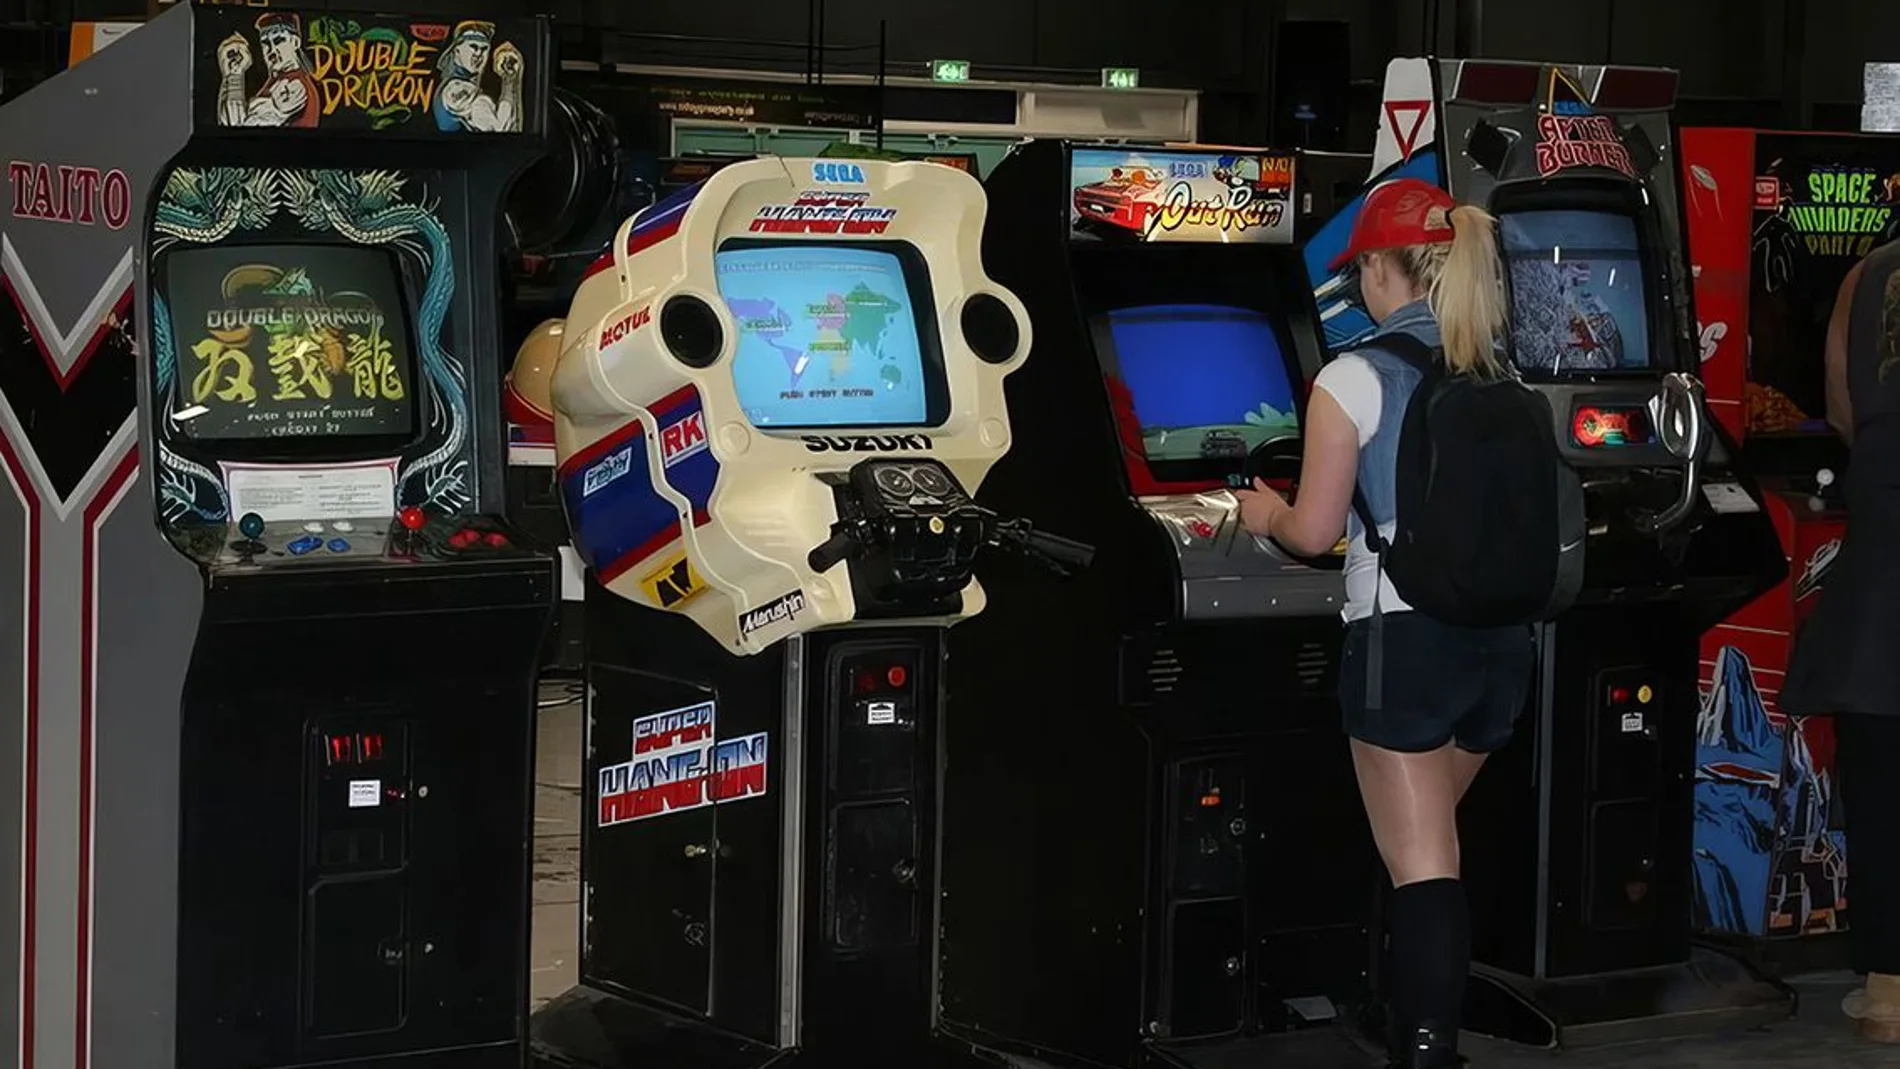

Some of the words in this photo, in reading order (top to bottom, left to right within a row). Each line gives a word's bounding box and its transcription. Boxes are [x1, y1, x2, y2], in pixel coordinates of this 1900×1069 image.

[309, 40, 438, 82] DOUBLE
[322, 70, 435, 115] DRAGON
[812, 162, 866, 184] SEGA
[1535, 140, 1636, 178] BURNER
[8, 160, 131, 230] TAITO
[1808, 172, 1877, 204] SPACE
[1788, 206, 1891, 232] INVADERS
[206, 307, 295, 328] DOUBLE
[661, 412, 707, 459] RK
[800, 434, 934, 452] SUZUKI
